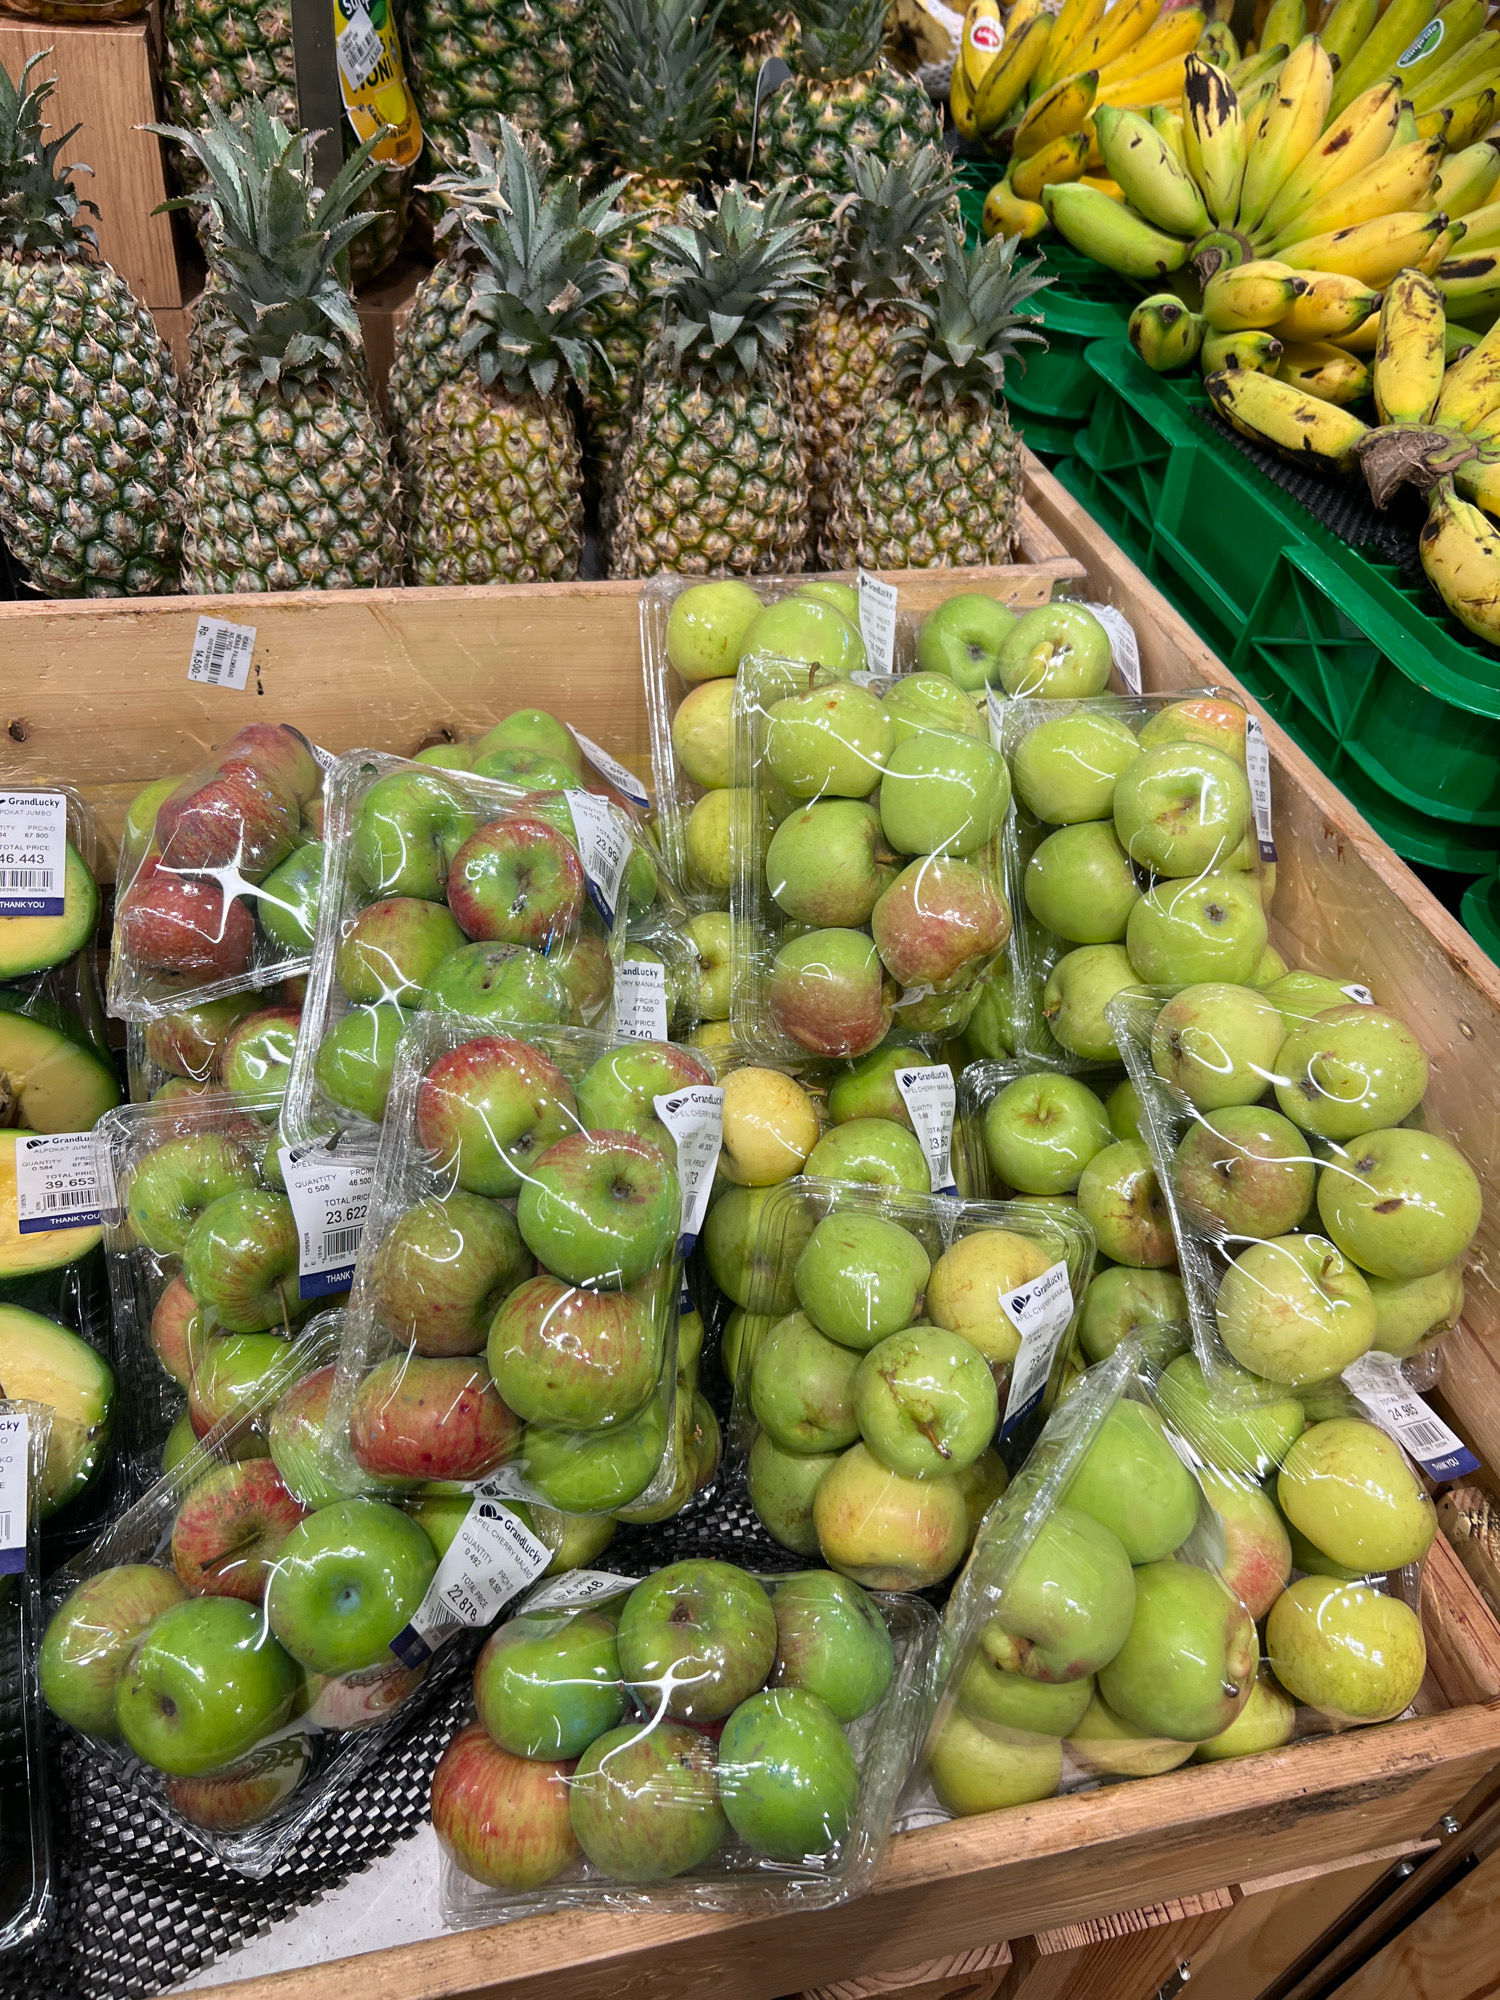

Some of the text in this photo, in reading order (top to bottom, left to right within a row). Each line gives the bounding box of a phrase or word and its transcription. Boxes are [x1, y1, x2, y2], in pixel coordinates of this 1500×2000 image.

[228, 650, 239, 678] PALEMBANG
[8, 797, 60, 808] GrandLucky
[28, 901, 45, 909] YOU
[622, 967, 659, 979] andLucky
[917, 1070, 949, 1081] GrandLucky
[911, 1103, 933, 1112] QUANTITY
[669, 1110, 689, 1120] APEL
[691, 1109, 710, 1119] CHERRY
[22, 1159, 62, 1167] QUANTITY
[45, 1177, 96, 1190] 39.653
[295, 1173, 337, 1189] QUANTITY
[307, 1177, 372, 1194] 0.508 46.500
[324, 1196, 350, 1207] TOTAL
[50, 1215, 80, 1225] THANK
[326, 1205, 368, 1225] 23.622
[326, 1271, 351, 1284] THANK
[1033, 1270, 1064, 1298] GrandLucky
[1015, 1311, 1032, 1323] APEL
[1446, 1457, 1459, 1468] YOU
[472, 1515, 490, 1532] APEL
[491, 1529, 515, 1557] CHERRY
[504, 1519, 542, 1566] GrandLucky
[461, 1532, 493, 1565] QUANTITY
[464, 1547, 482, 1568] 0.492
[461, 1572, 489, 1610] TOTAL PRICE
[554, 1587, 576, 1602] TOTAL
[447, 1583, 478, 1622] 22.878
